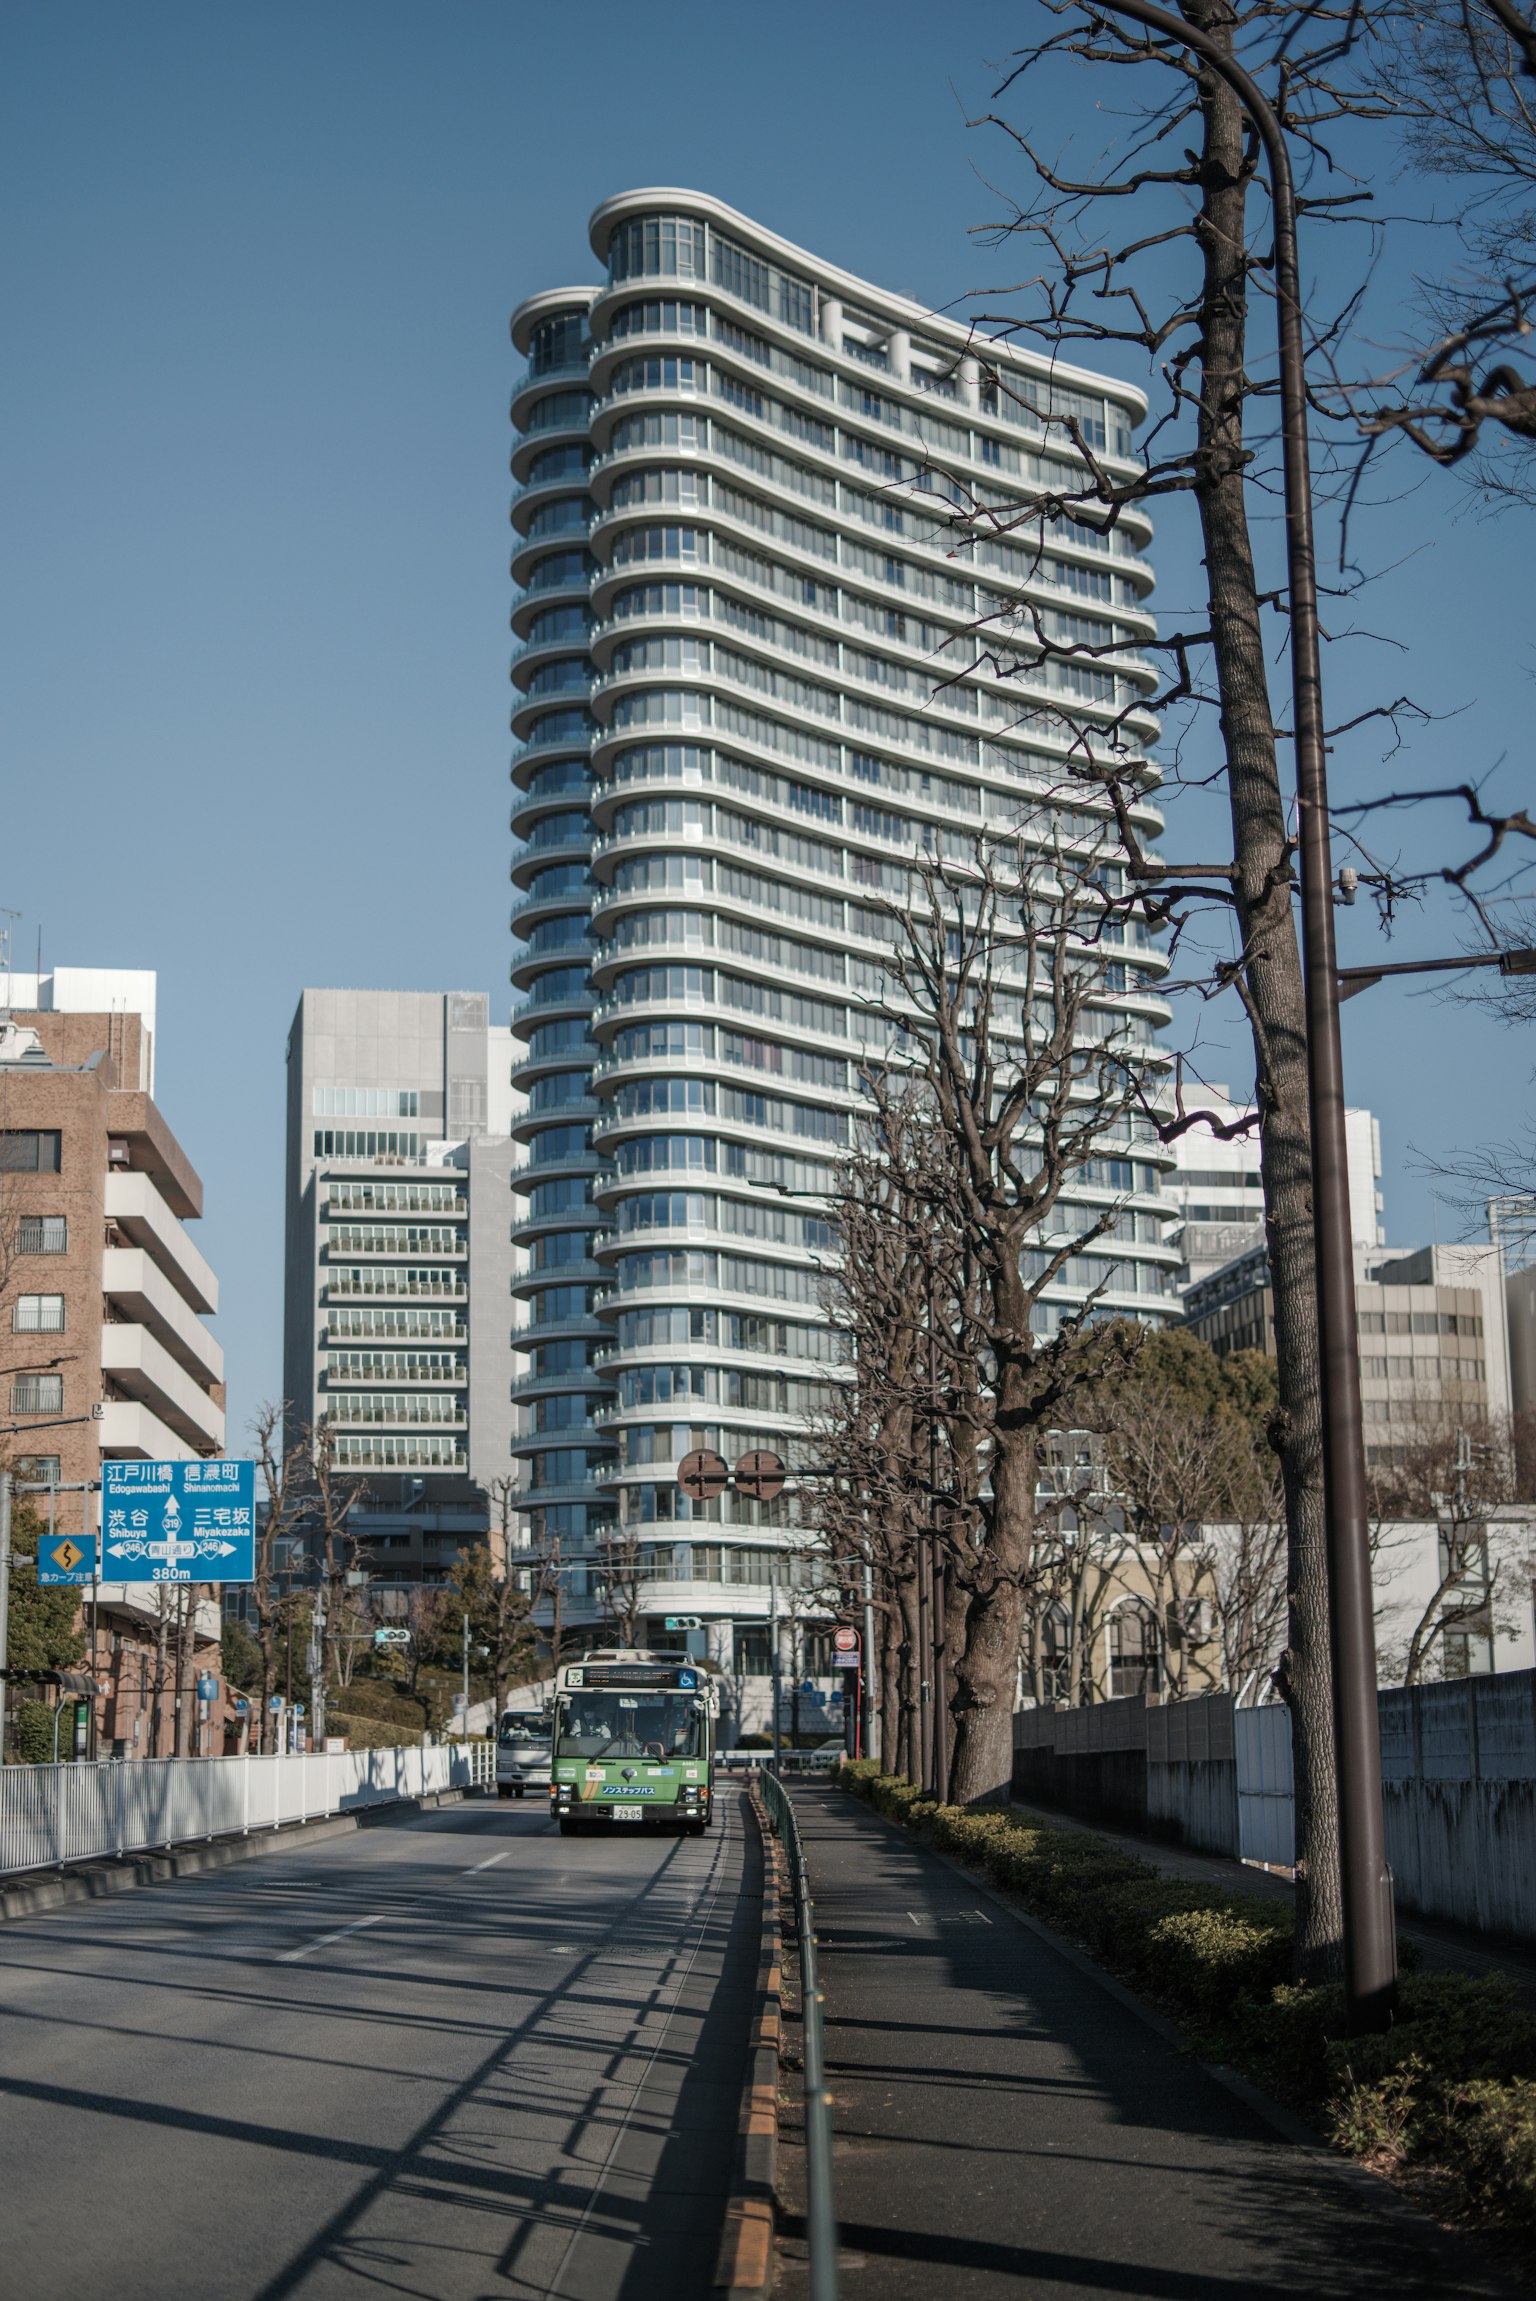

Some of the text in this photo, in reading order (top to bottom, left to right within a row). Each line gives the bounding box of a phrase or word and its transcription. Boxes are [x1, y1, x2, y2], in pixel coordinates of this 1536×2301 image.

[107, 1463, 239, 1483] 江戸川橋 信濃町
[109, 1483, 240, 1495] Edogawabashi Shinanomachi
[108, 1509, 149, 1528] 渋谷
[194, 1508, 250, 1526] 三宅坂
[164, 1518, 179, 1529] 319
[109, 1529, 147, 1539] Shibuya
[194, 1527, 250, 1538] Miyakezaka
[126, 1543, 141, 1553] 246
[151, 1544, 192, 1555] 青山通り
[203, 1541, 218, 1552] 246
[152, 1568, 190, 1580] 380m
[603, 1786, 655, 1794] ノンステップバス
[618, 1809, 641, 1819] 29-05
